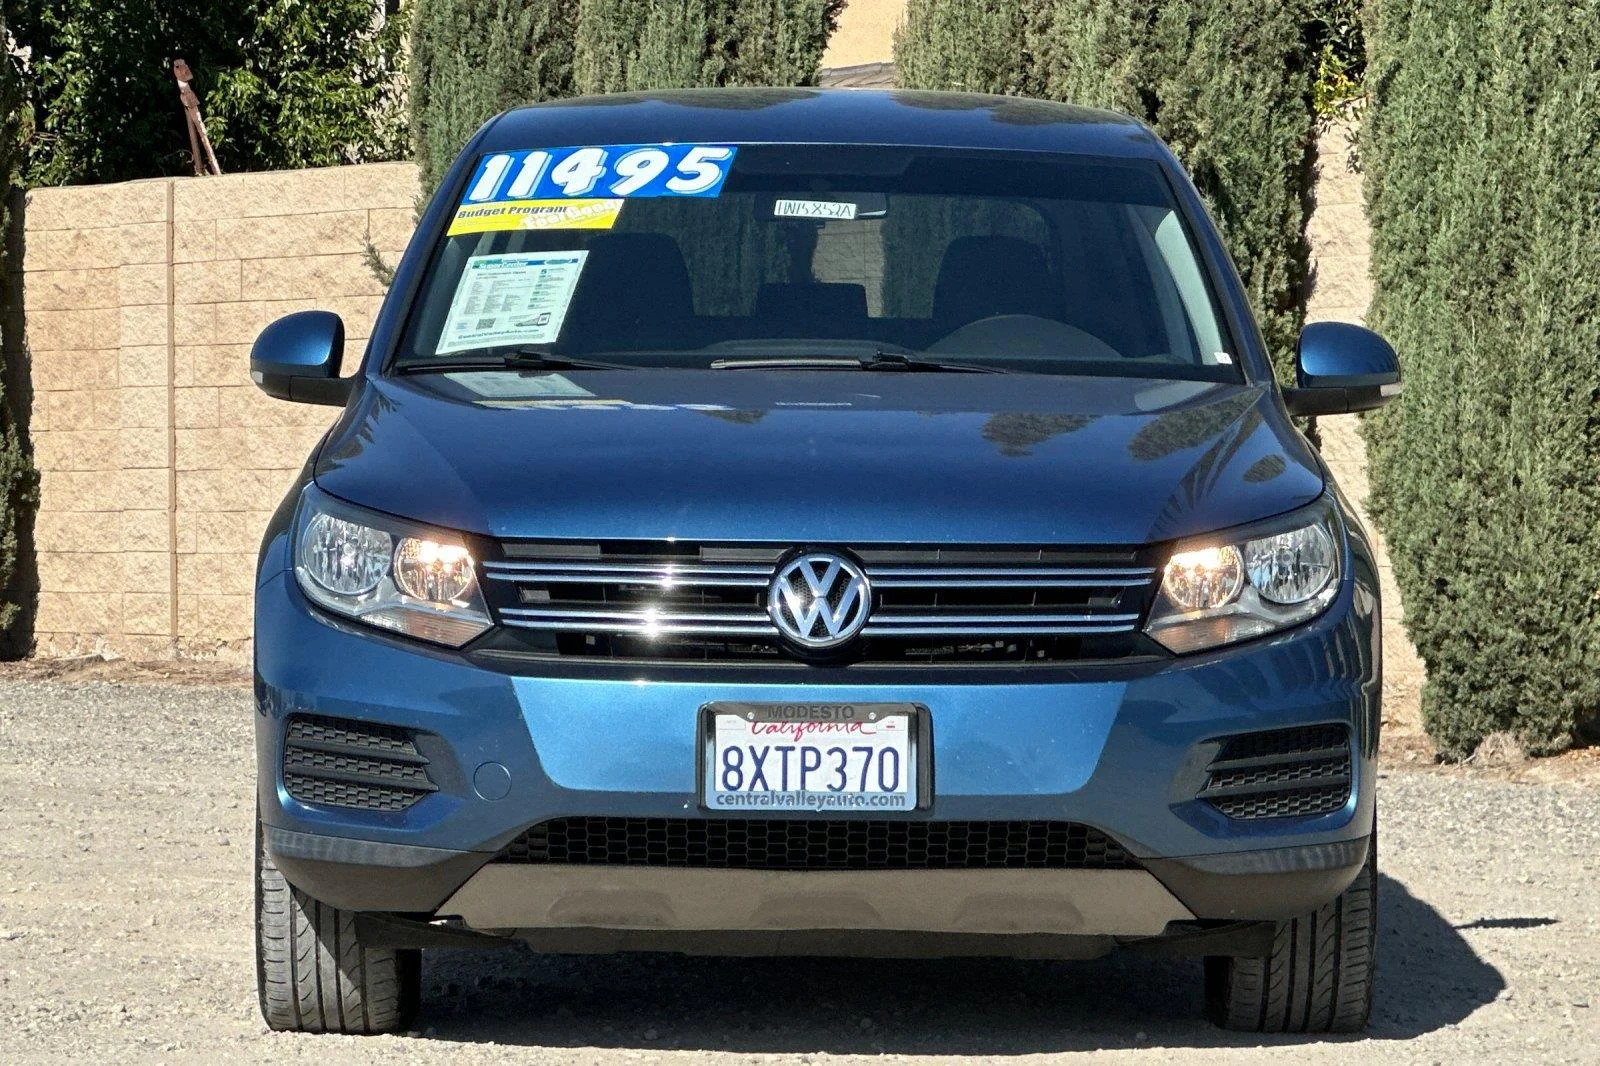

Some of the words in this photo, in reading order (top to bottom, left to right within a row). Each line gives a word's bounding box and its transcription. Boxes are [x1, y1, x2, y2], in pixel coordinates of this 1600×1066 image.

[469, 147, 732, 201] 11495
[458, 207, 506, 219] Budget
[508, 205, 567, 217] Program
[774, 556, 864, 641] VW
[767, 705, 855, 720] MODESTO
[751, 721, 877, 742] California
[722, 745, 900, 792] 8XTP370
[716, 790, 906, 809] centralvalleyauto.com
